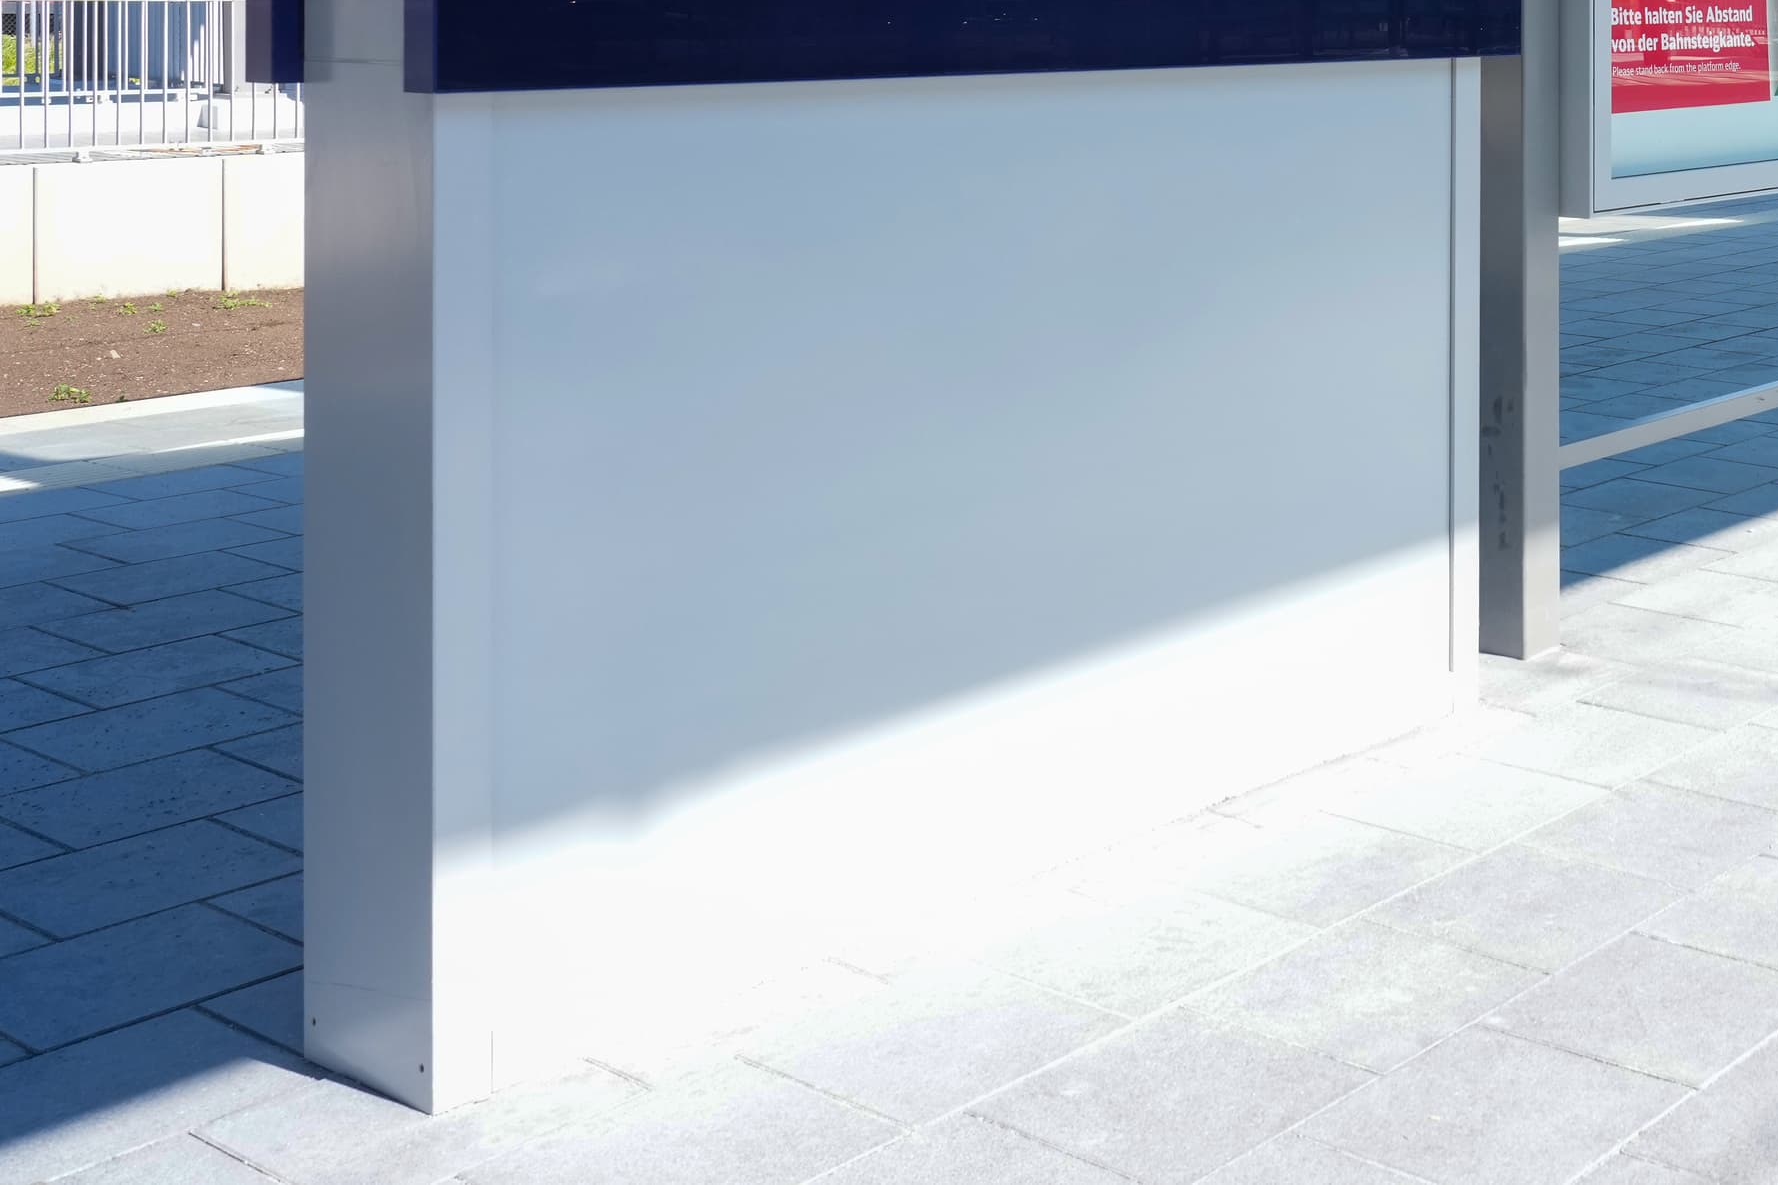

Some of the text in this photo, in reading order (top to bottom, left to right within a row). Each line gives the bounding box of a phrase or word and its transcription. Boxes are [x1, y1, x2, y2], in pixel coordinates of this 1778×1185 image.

[1611, 5, 1753, 26] Bitte halten Sie Abstand
[1611, 31, 1755, 53] von der Bahnsteigkante.
[1612, 61, 1741, 76] Please stand back from the platform edge.
